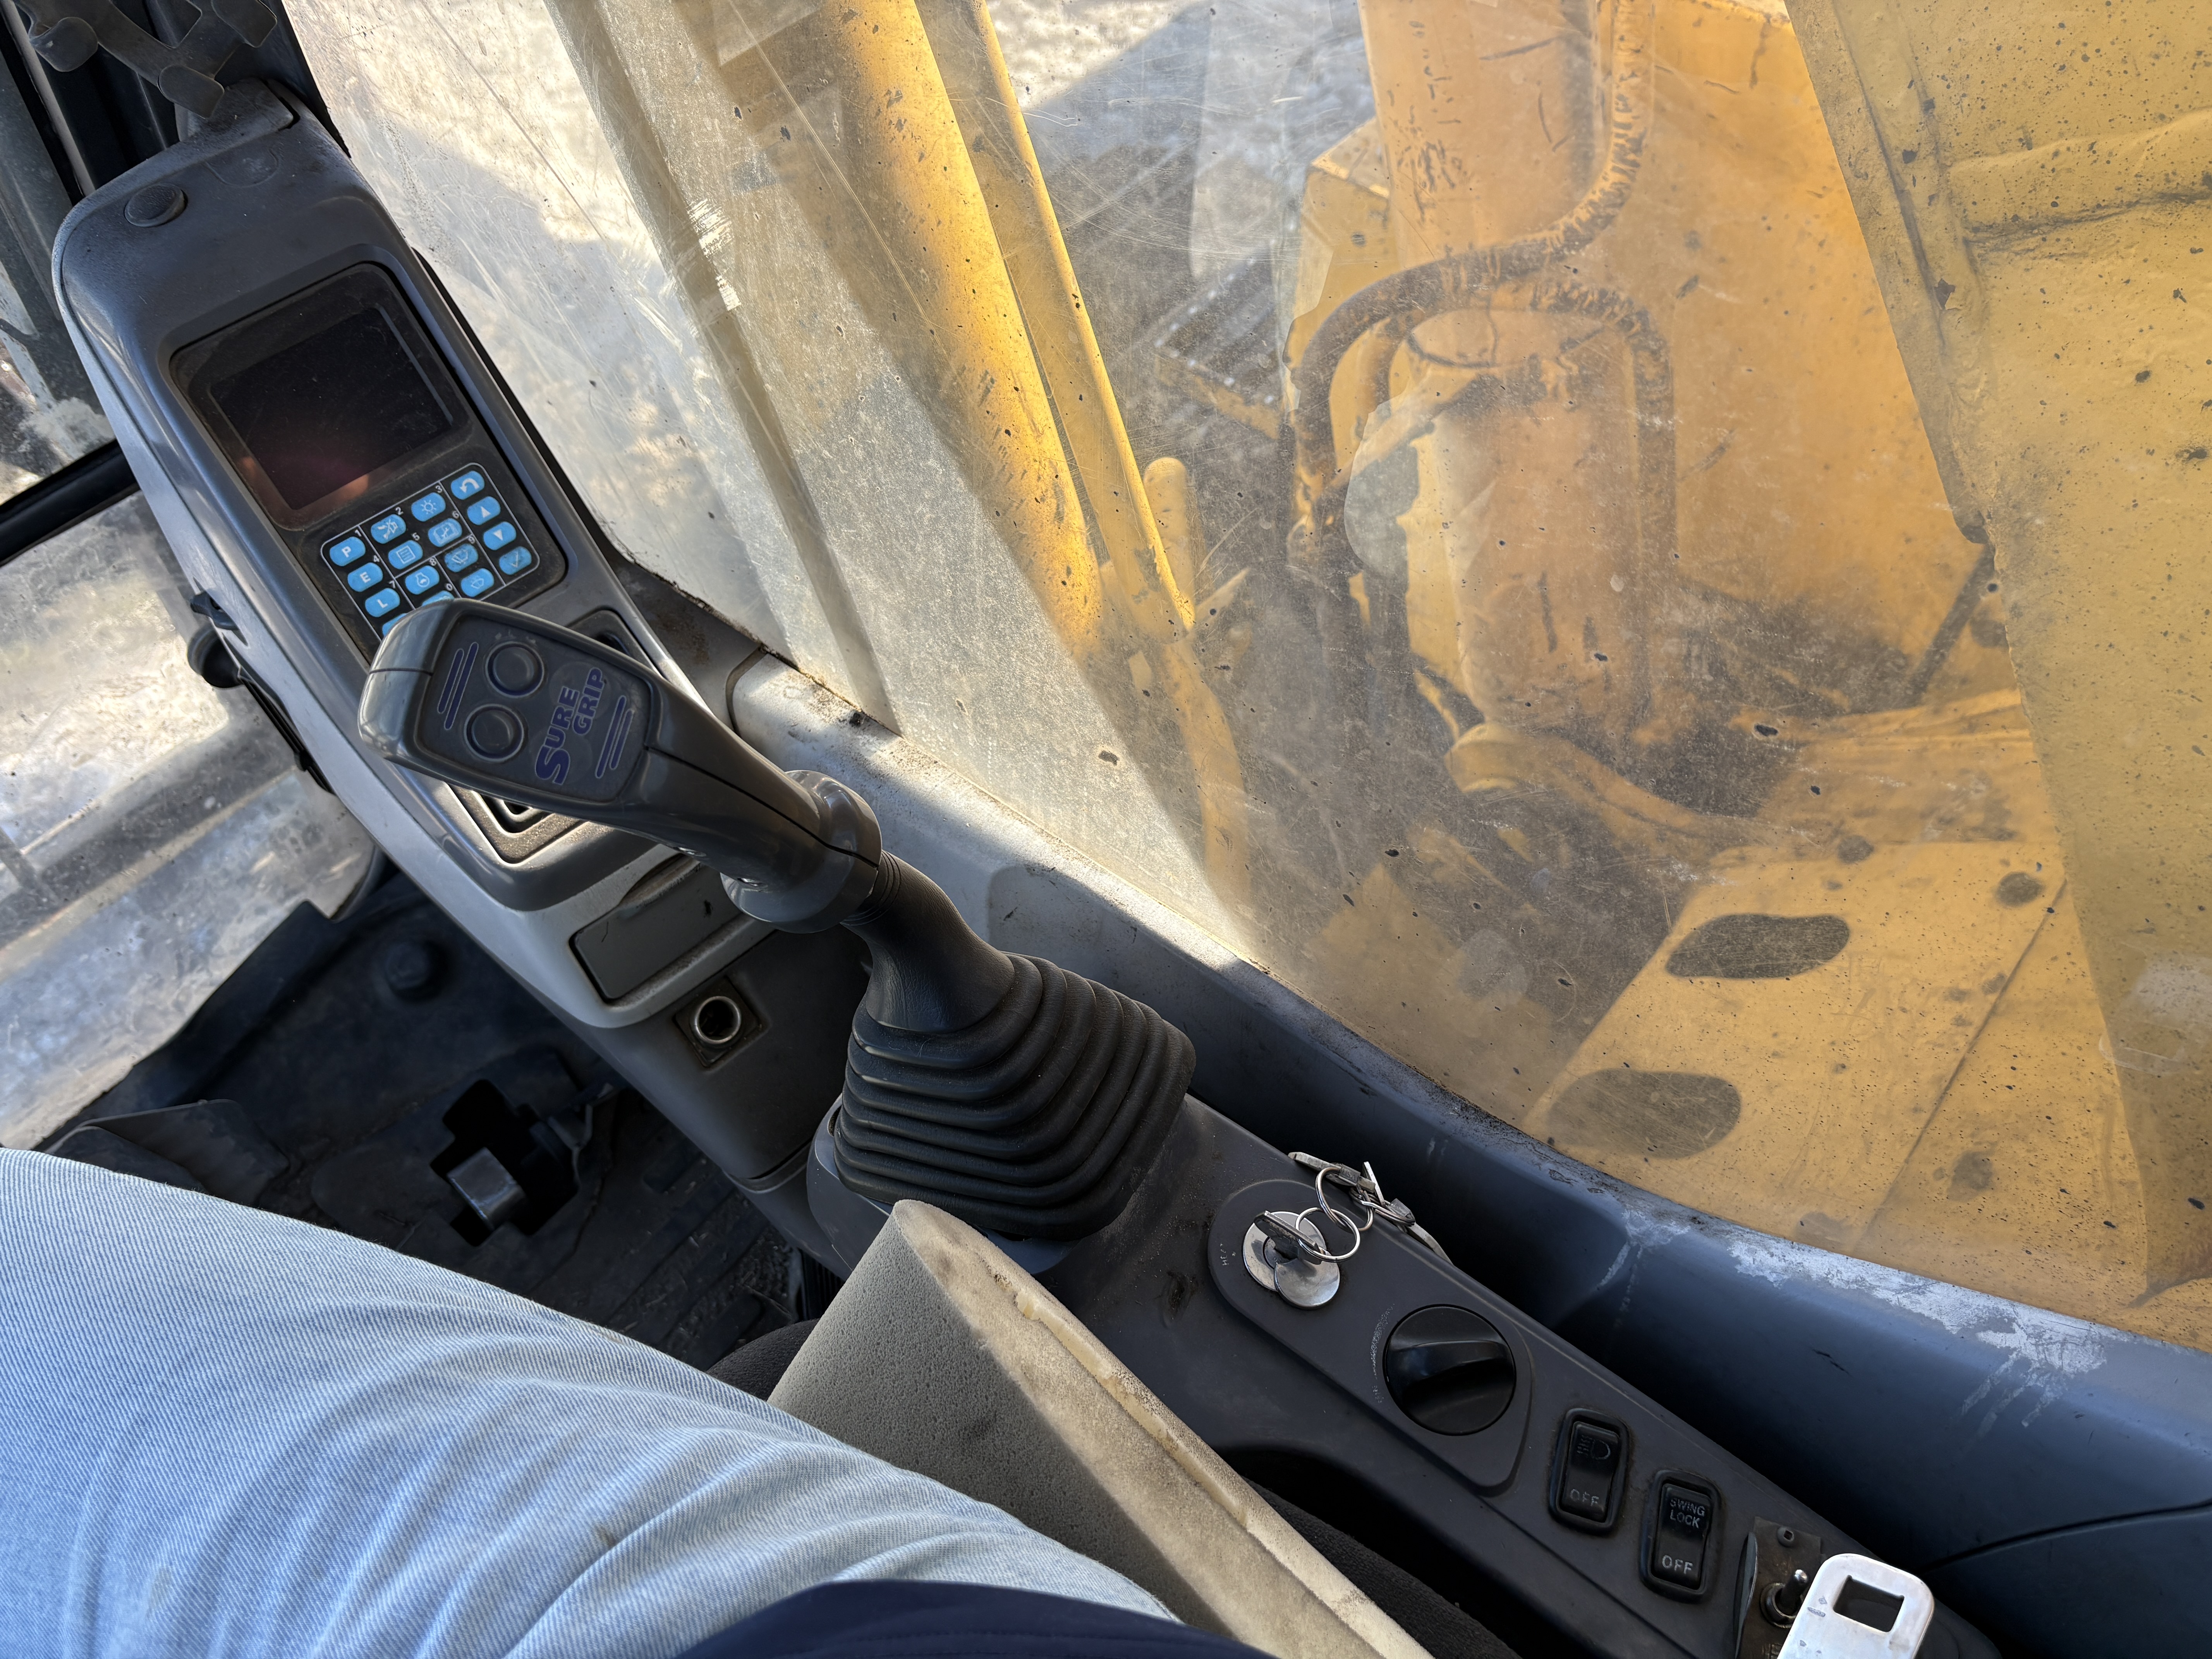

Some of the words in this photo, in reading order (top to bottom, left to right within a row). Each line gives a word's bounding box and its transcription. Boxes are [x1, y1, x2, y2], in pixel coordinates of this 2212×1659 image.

[435, 485, 443, 493] 3
[395, 507, 404, 515] 2
[452, 510, 460, 519] 6
[412, 532, 420, 541] 5
[342, 546, 352, 558] P
[429, 558, 437, 566] 8
[360, 572, 371, 583] E
[389, 580, 396, 589] 7
[377, 599, 388, 608] L
[572, 667, 605, 736] GRIP
[535, 686, 580, 785] SURE
[1670, 1499, 1705, 1517] SWING
[1670, 1509, 1700, 1529] LOCK
[1662, 1555, 1693, 1575] OFF
